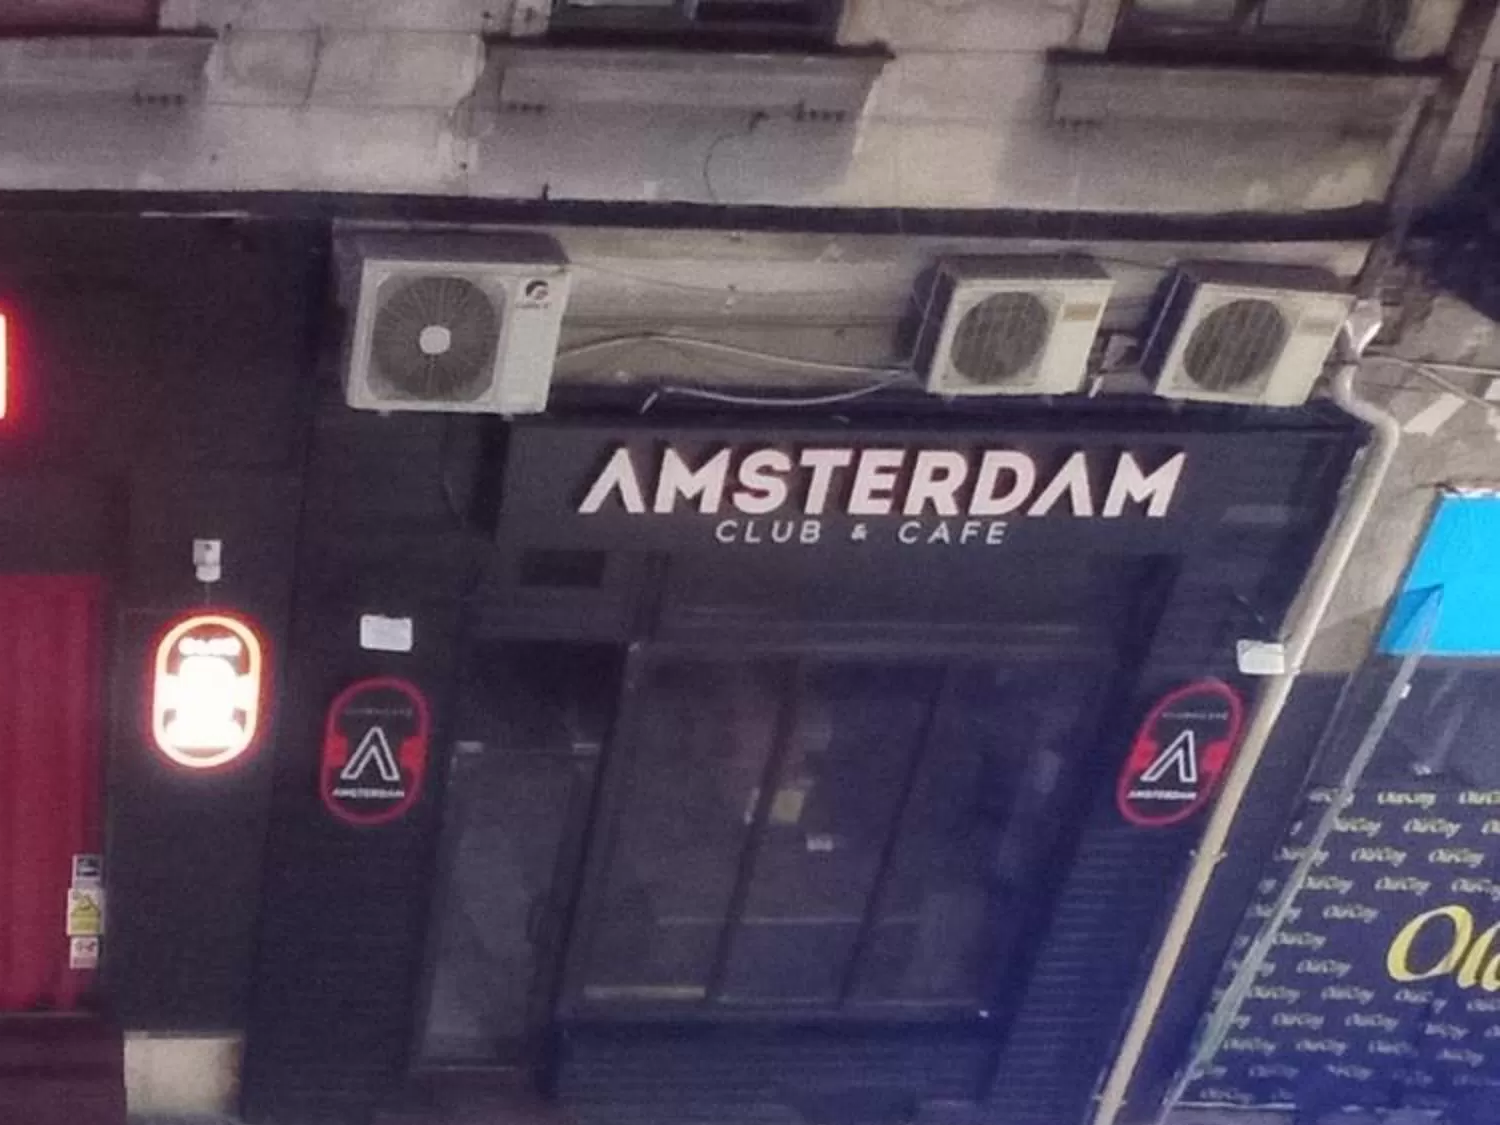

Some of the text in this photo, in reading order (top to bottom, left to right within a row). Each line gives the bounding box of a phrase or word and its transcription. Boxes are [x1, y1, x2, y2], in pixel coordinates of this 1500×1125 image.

[578, 447, 1187, 518] AMSTERDAM
[714, 519, 822, 544] CLUB
[897, 521, 1007, 545] CAFE
